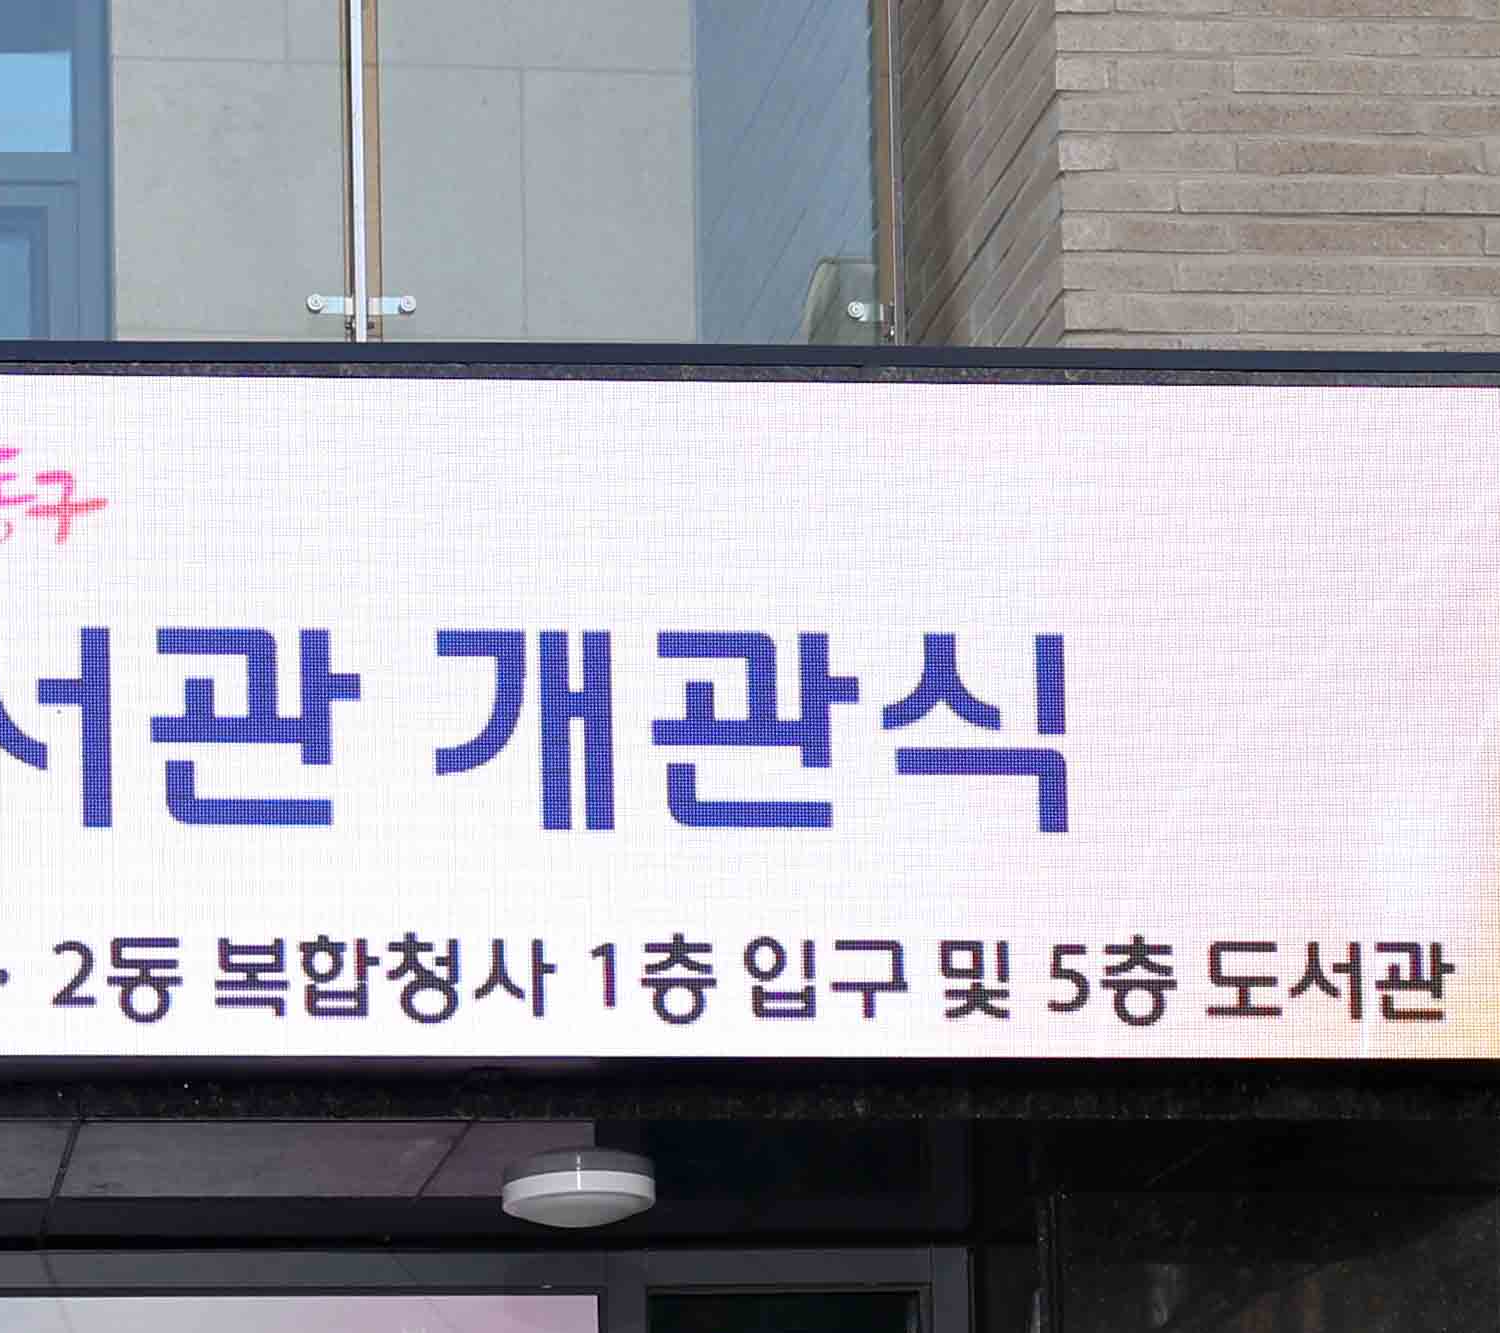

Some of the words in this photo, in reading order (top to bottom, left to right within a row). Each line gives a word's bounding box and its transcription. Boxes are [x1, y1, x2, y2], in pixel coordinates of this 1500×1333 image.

[436, 630, 1069, 834] 개관식
[214, 931, 557, 1025] 복합청사
[590, 933, 718, 1026] 1층
[742, 935, 909, 1020] 입구
[1047, 934, 1178, 1028] 5층
[1205, 940, 1456, 1023] 도서관
